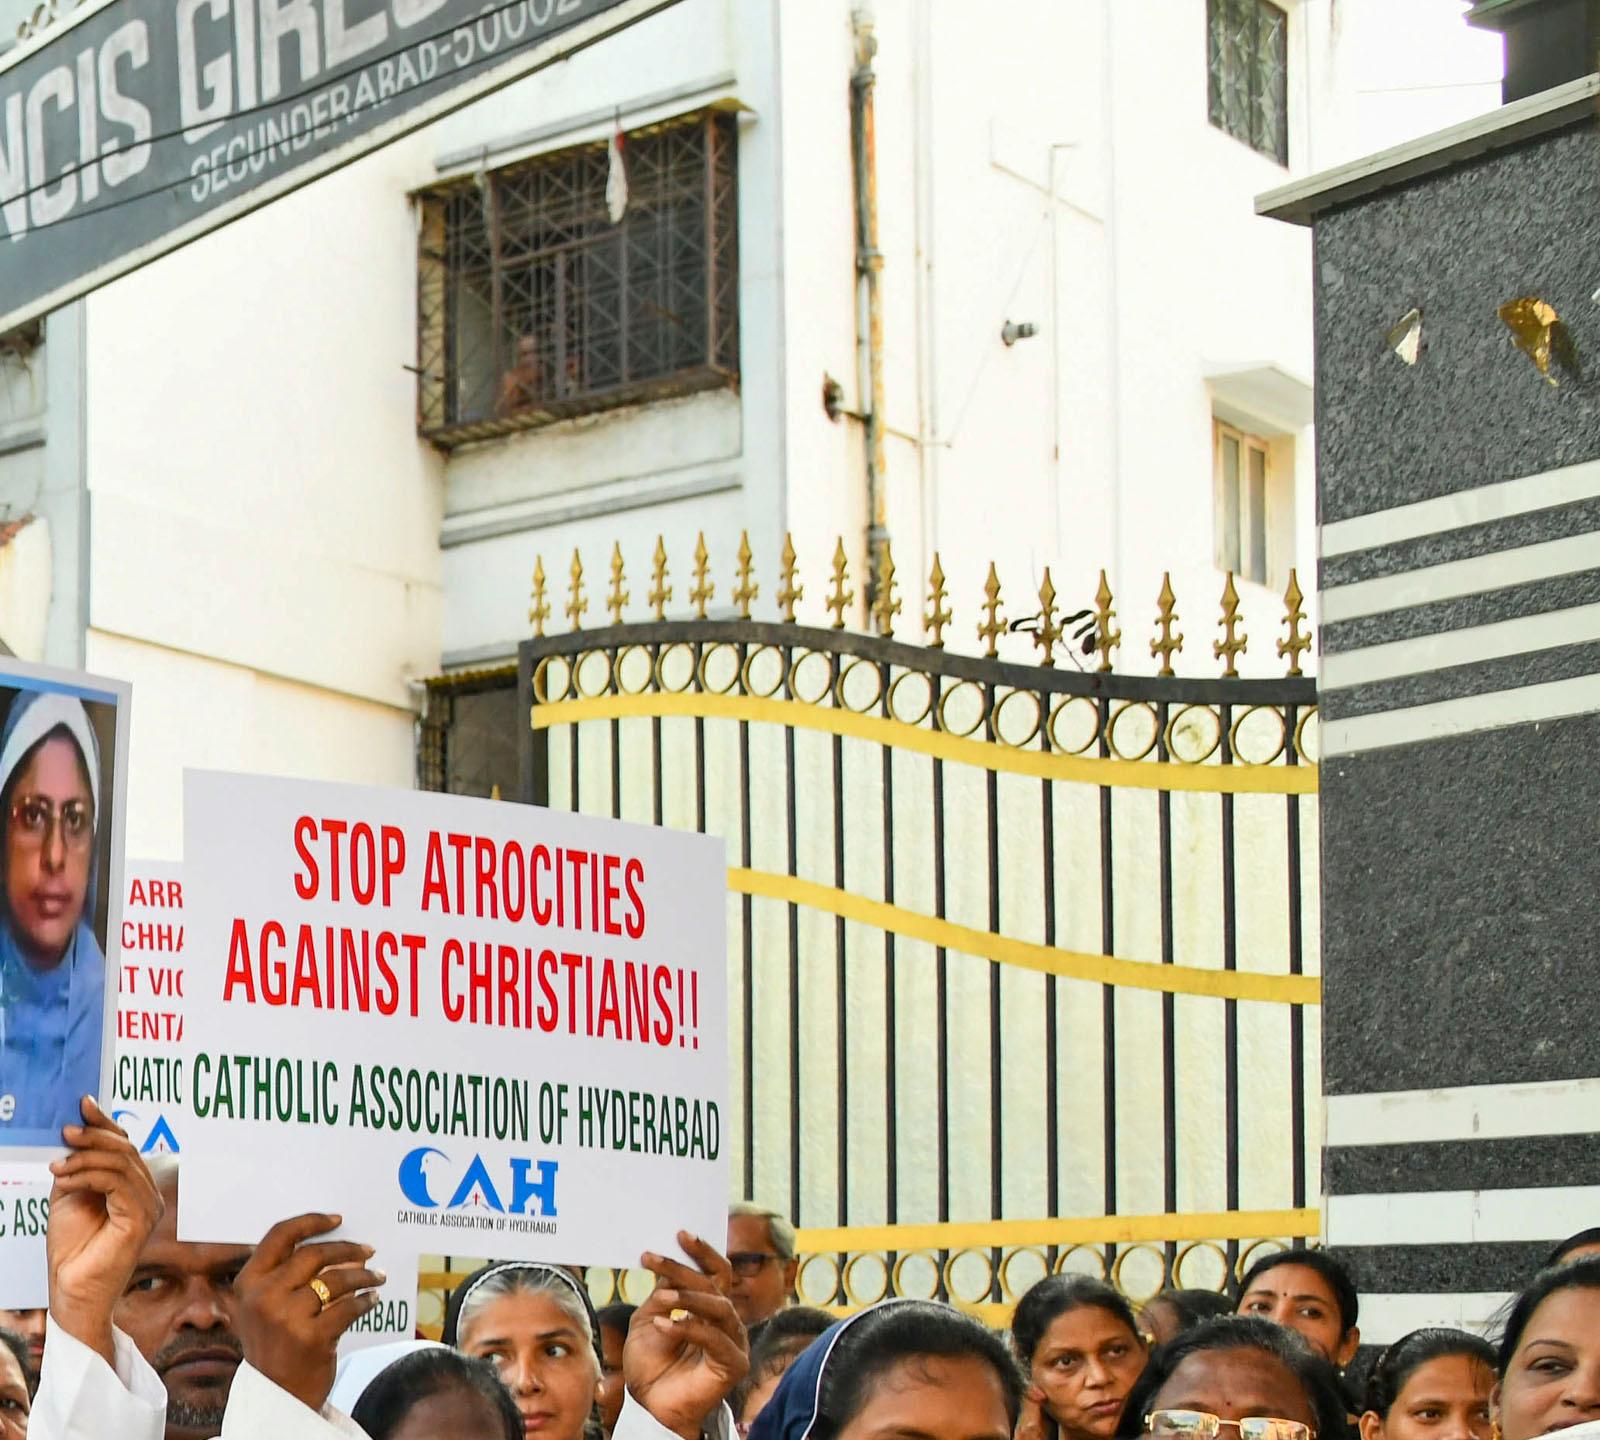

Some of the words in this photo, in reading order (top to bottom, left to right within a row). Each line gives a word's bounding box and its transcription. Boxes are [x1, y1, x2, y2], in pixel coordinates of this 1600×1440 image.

[293, 815, 406, 904] STOP
[420, 829, 646, 939] ATROCITIES
[222, 918, 426, 1018] AGAINST
[440, 939, 700, 1050] CHRISTIANS!!
[192, 1052, 339, 1126] CATHOLIC
[347, 1063, 530, 1142] ASSOCIATION
[538, 1081, 570, 1146] OF
[578, 1085, 720, 1162] HYDERABAD
[397, 1210, 438, 1226] CATHOLIC
[440, 1213, 494, 1231] ASSOCIATION
[496, 1218, 506, 1231] OF
[509, 1218, 557, 1235] HYDERABAD
[398, 1146, 558, 1216] CAH
